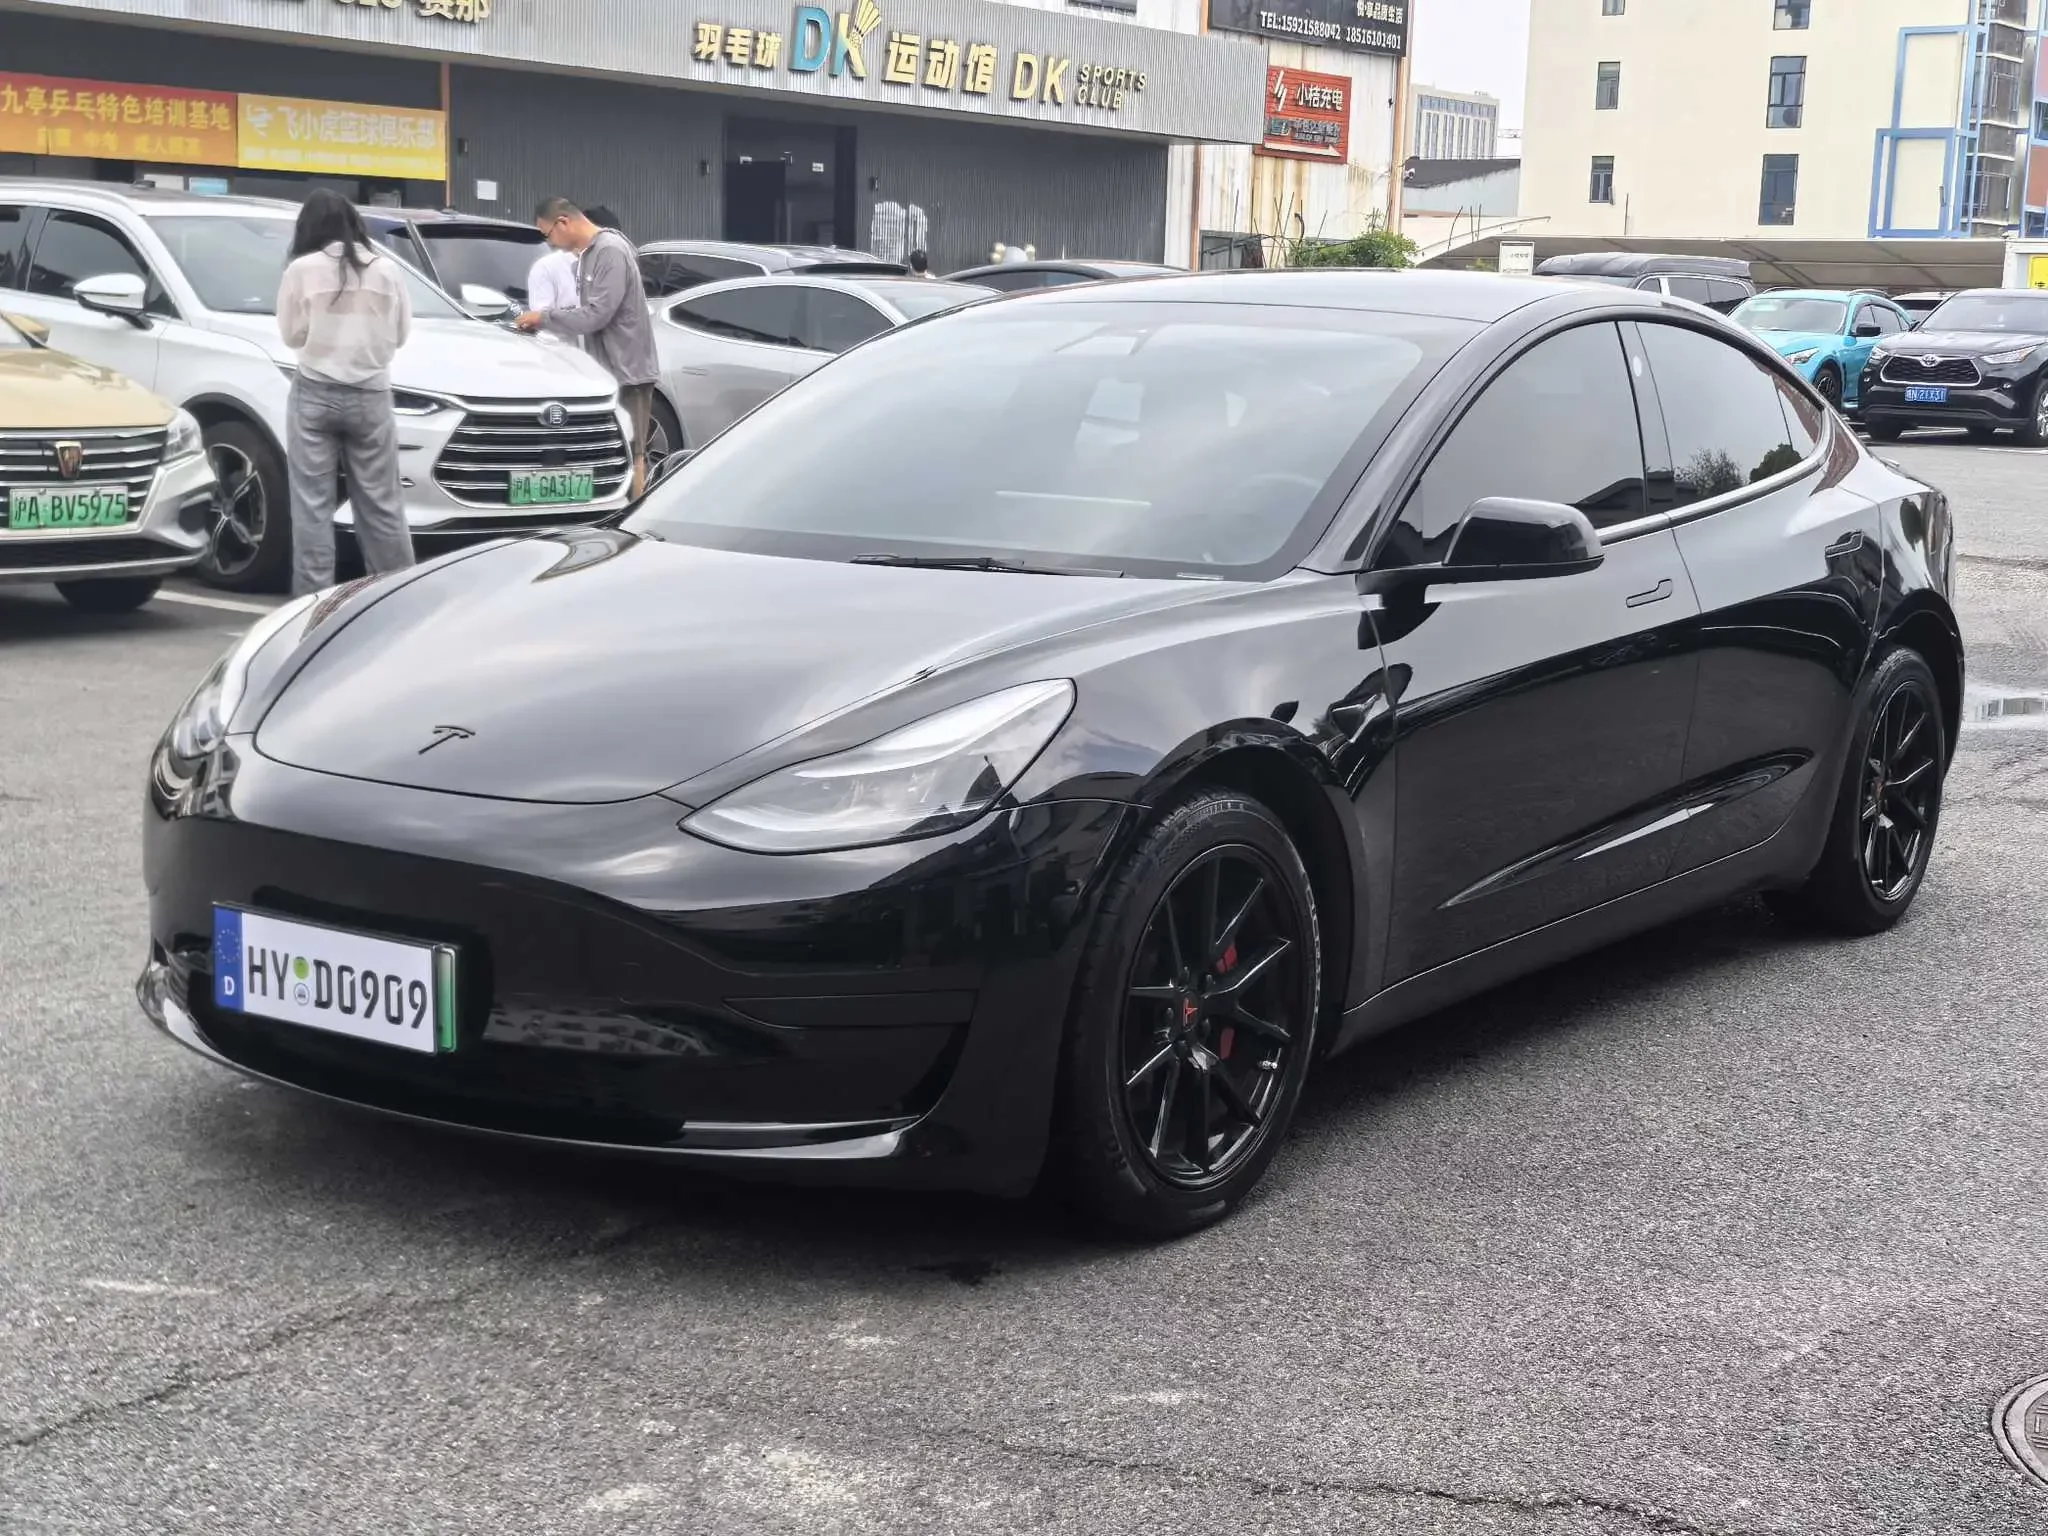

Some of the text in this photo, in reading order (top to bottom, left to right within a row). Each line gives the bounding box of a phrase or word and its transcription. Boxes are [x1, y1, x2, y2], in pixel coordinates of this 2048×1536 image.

[1260, 11, 1401, 49] TEL:15921588042 18516101401
[693, 22, 782, 68] 羽毛球
[884, 31, 998, 94] 运动馆
[1011, 52, 1070, 104] DK
[1079, 63, 1148, 90] SPORTS
[1, 83, 231, 131] 九亭乒乓特色培训基地
[1077, 85, 1123, 109] CLUB
[1296, 81, 1343, 111] 小桔充电
[223, 975, 235, 996] D
[248, 945, 289, 1001] HY
